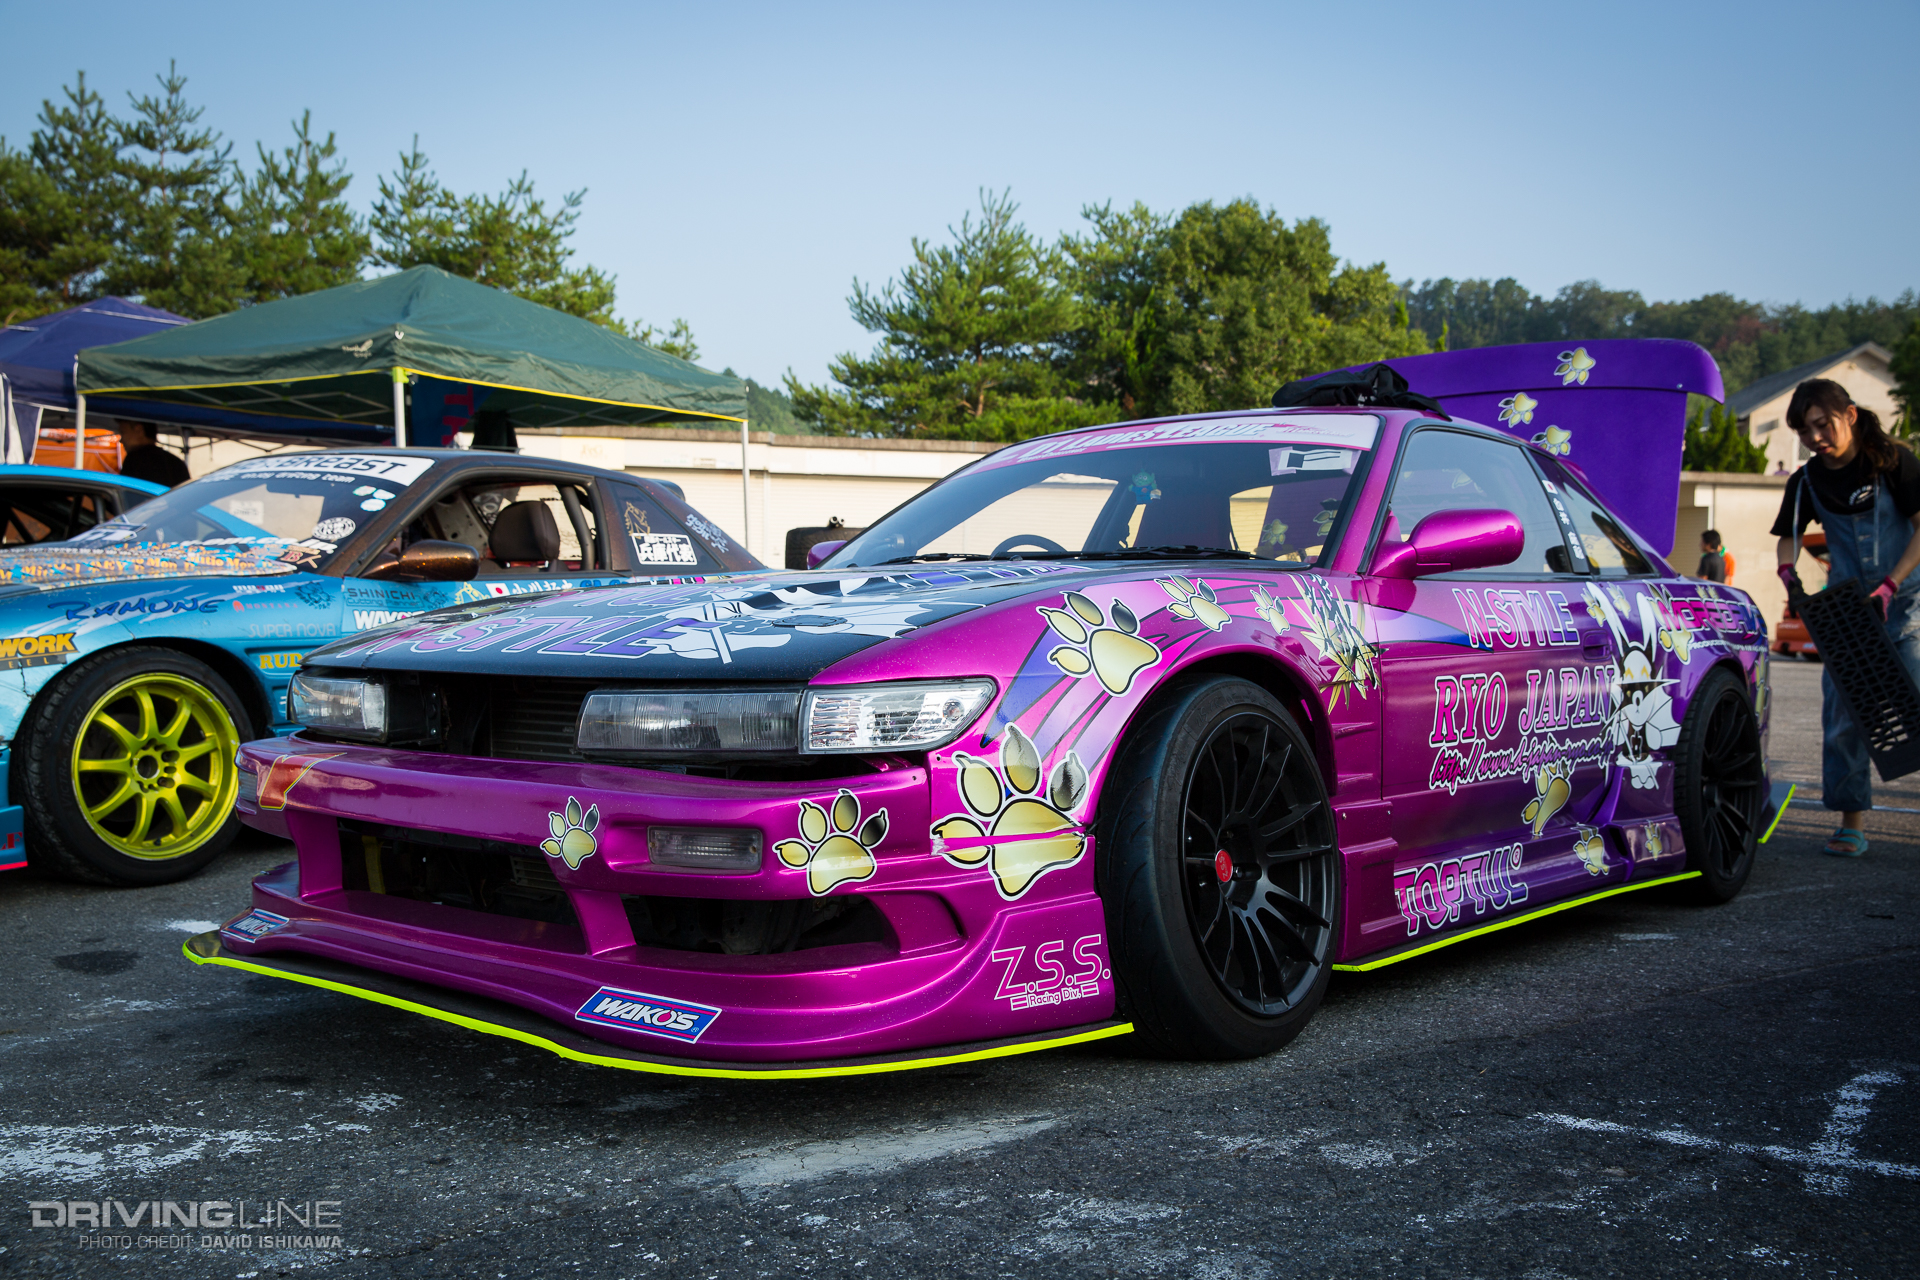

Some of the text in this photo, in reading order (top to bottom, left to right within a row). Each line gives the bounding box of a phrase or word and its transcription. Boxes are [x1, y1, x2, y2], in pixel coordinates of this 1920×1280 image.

[346, 588, 415, 600] SHINICHI
[296, 622, 336, 637] NOVA
[1452, 587, 1580, 648] N-STYLE
[0, 633, 76, 658] WORK
[1429, 665, 1615, 748] RYO JAPAN
[992, 934, 1111, 1000] Z.S.S.
[1028, 988, 1082, 1008] Racing Div.
[592, 997, 700, 1031] WAKO'S
